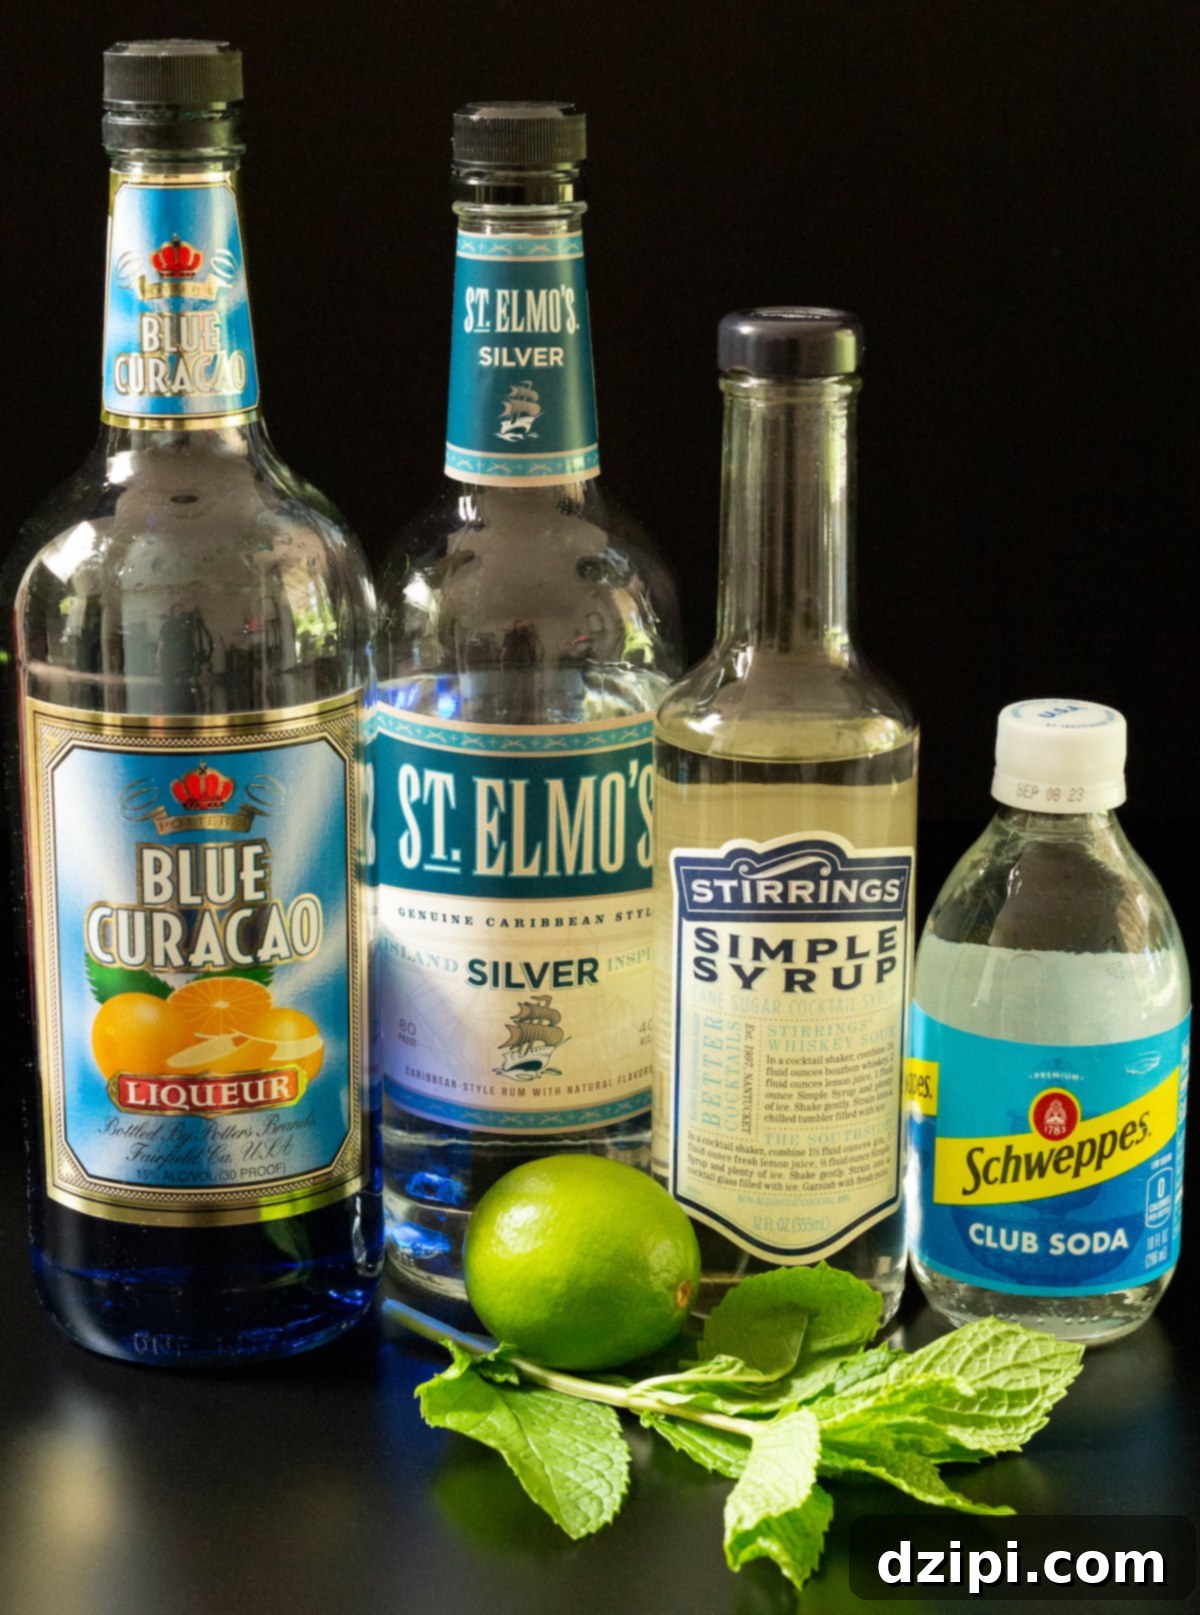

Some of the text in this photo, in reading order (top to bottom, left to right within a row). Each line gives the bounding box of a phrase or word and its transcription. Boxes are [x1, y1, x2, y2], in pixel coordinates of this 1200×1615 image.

[140, 311, 222, 353] BLUE
[479, 346, 564, 367] SILVER
[113, 351, 247, 395] CURACAO
[1016, 782, 1039, 799] SEP
[1067, 786, 1084, 802] 23
[398, 763, 461, 874] ST.
[138, 841, 271, 906] BLUE
[690, 878, 901, 904] STIRRINGS
[398, 907, 474, 926] GENUINE
[486, 914, 605, 928] CARIBBEAN
[84, 895, 323, 971] CURACAO
[693, 925, 898, 963] SIMPLE
[382, 936, 459, 973] ISLAND
[466, 957, 600, 990] SILVER
[692, 956, 897, 993] SYRUP
[732, 994, 781, 1015] SUGAR
[788, 996, 857, 1017] COCKTAIL
[399, 1018, 417, 1036] 80
[767, 1036, 852, 1053] WHISKEY
[766, 1054, 777, 1065] In
[785, 1055, 824, 1065] cocktail
[766, 1066, 789, 1077] fluid
[790, 1069, 823, 1077] ounces
[824, 1063, 860, 1076] bourbon
[701, 1014, 724, 1128] BETTER
[723, 1020, 742, 1132] COCKTAILS
[1033, 1070, 1080, 1081] PREMIUM
[126, 1075, 292, 1110] LIQUEUR
[501, 1086, 527, 1097] RUM
[532, 1085, 562, 1097] WITH
[566, 1079, 613, 1095] NATURAL
[764, 1091, 794, 1101] ounce
[797, 1090, 828, 1102] Simple
[831, 1088, 857, 1100] Syrup
[859, 1084, 873, 1095] and
[765, 1078, 788, 1089] fluid
[790, 1080, 823, 1089] ounces
[825, 1077, 852, 1088] lemon
[740, 1073, 754, 1135] NANTUCKET
[764, 1101, 775, 1112] of
[794, 1102, 822, 1112] Shake
[764, 1113, 797, 1124] chilled
[798, 1113, 834, 1124] tumbler
[835, 1110, 857, 1121] filled
[858, 1105, 875, 1116] with
[98, 1115, 163, 1141] Bottled
[161, 1121, 192, 1147] By
[764, 1133, 800, 1147] THE
[1043, 1124, 1067, 1136] 1783
[687, 1141, 706, 1156] fluid
[706, 1150, 732, 1162] ounce
[734, 1154, 758, 1167] fresh
[760, 1158, 790, 1168] lemon
[828, 1155, 848, 1167] fluid
[848, 1152, 870, 1164] ounce
[702, 1137, 734, 1151] cocktail
[768, 1148, 806, 1157] combine
[822, 1144, 842, 1156] fluid
[842, 1141, 871, 1153] ounces
[239, 1162, 288, 1178] PROOF)
[687, 1152, 708, 1169] Syrup
[710, 1163, 726, 1173] and
[727, 1166, 755, 1178] plenty
[757, 1169, 768, 1179] of
[789, 1170, 816, 1180] Shake
[687, 1166, 716, 1181] cocktail
[716, 1175, 738, 1186] glass
[738, 1178, 762, 1190] filled
[763, 1181, 784, 1191] with
[801, 1181, 836, 1191] Garnish
[838, 1176, 855, 1188] with
[1157, 1177, 1165, 1198] 0
[777, 1217, 789, 1231] OZ
[968, 1223, 1128, 1254] CLUB SODA
